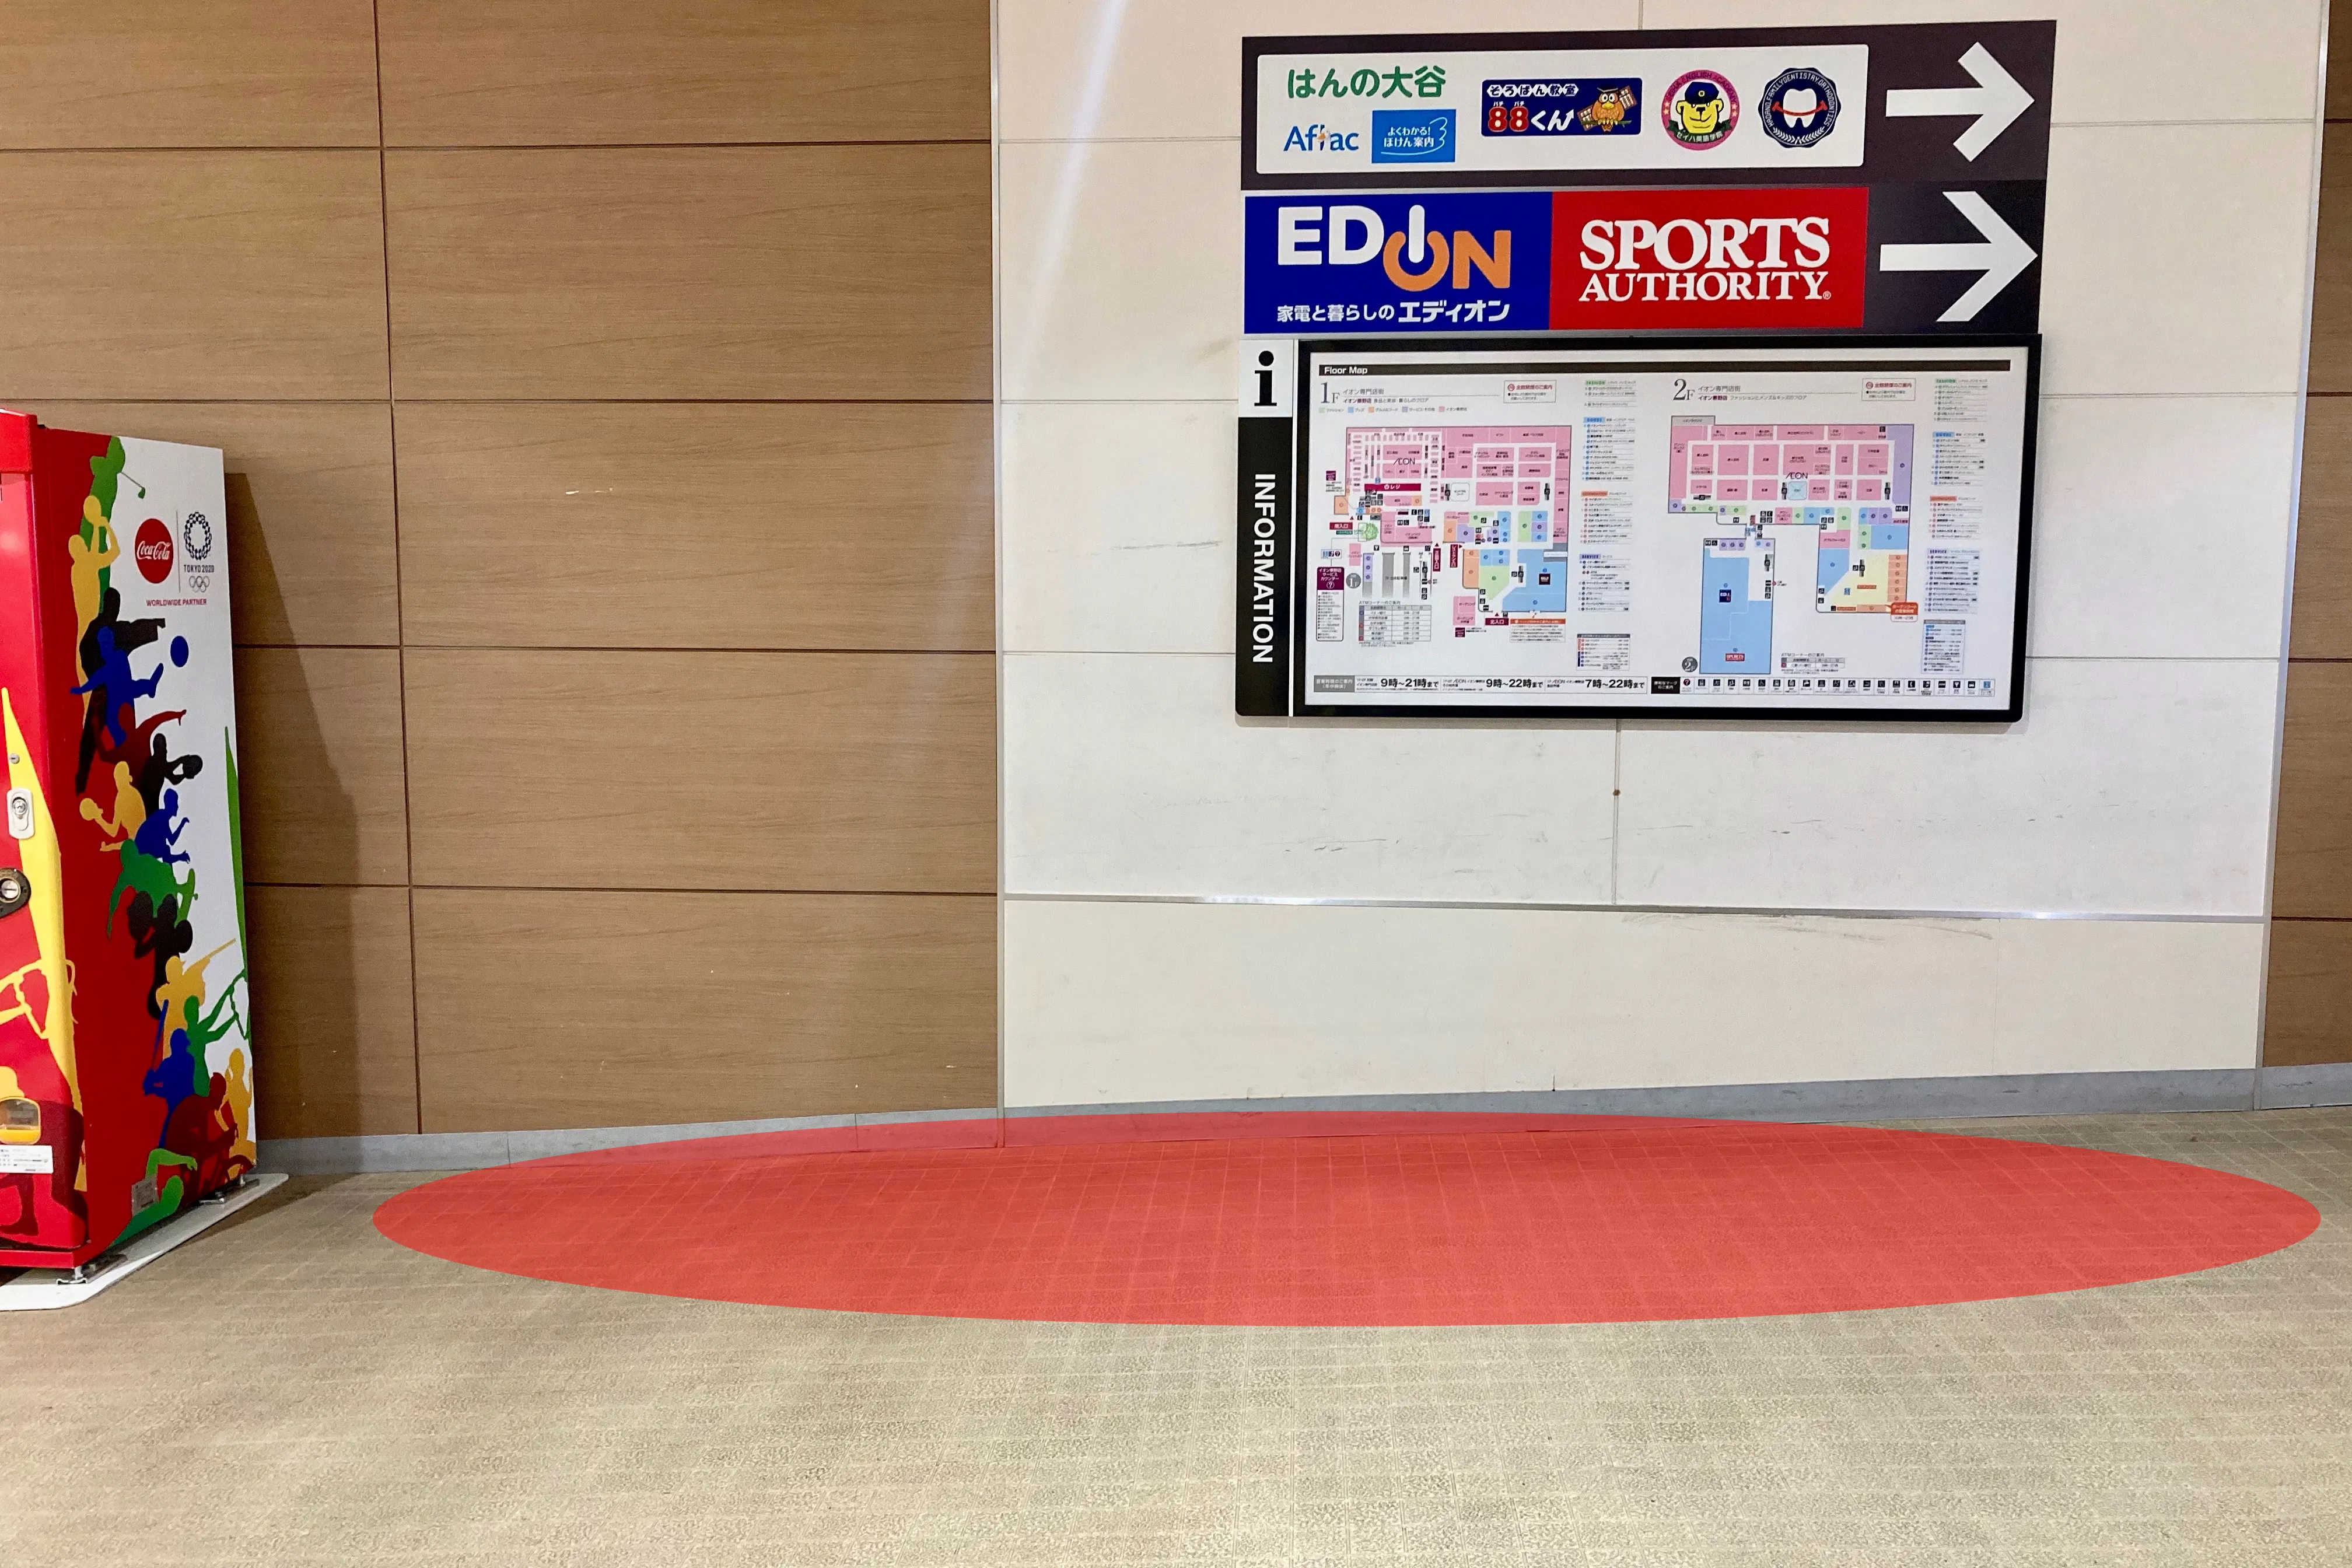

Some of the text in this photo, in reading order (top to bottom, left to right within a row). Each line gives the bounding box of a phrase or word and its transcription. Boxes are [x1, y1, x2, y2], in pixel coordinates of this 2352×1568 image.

[1287, 65, 1446, 99] はんの大谷
[1489, 84, 1577, 96] そろばん教室
[1283, 124, 1359, 151] Aflac
[1383, 136, 1434, 148] ほけん案内
[1278, 204, 1512, 292] EDION
[1580, 216, 1831, 271] SPORTS
[1277, 299, 1510, 323] 家電と暮らしの エディオン
[1324, 366, 1368, 375] Floor Map
[1321, 382, 1340, 404] 1F
[1673, 378, 1695, 401] 2F
[184, 565, 215, 573] TOKYO 2020
[1252, 474, 1276, 663] INFORMATION
